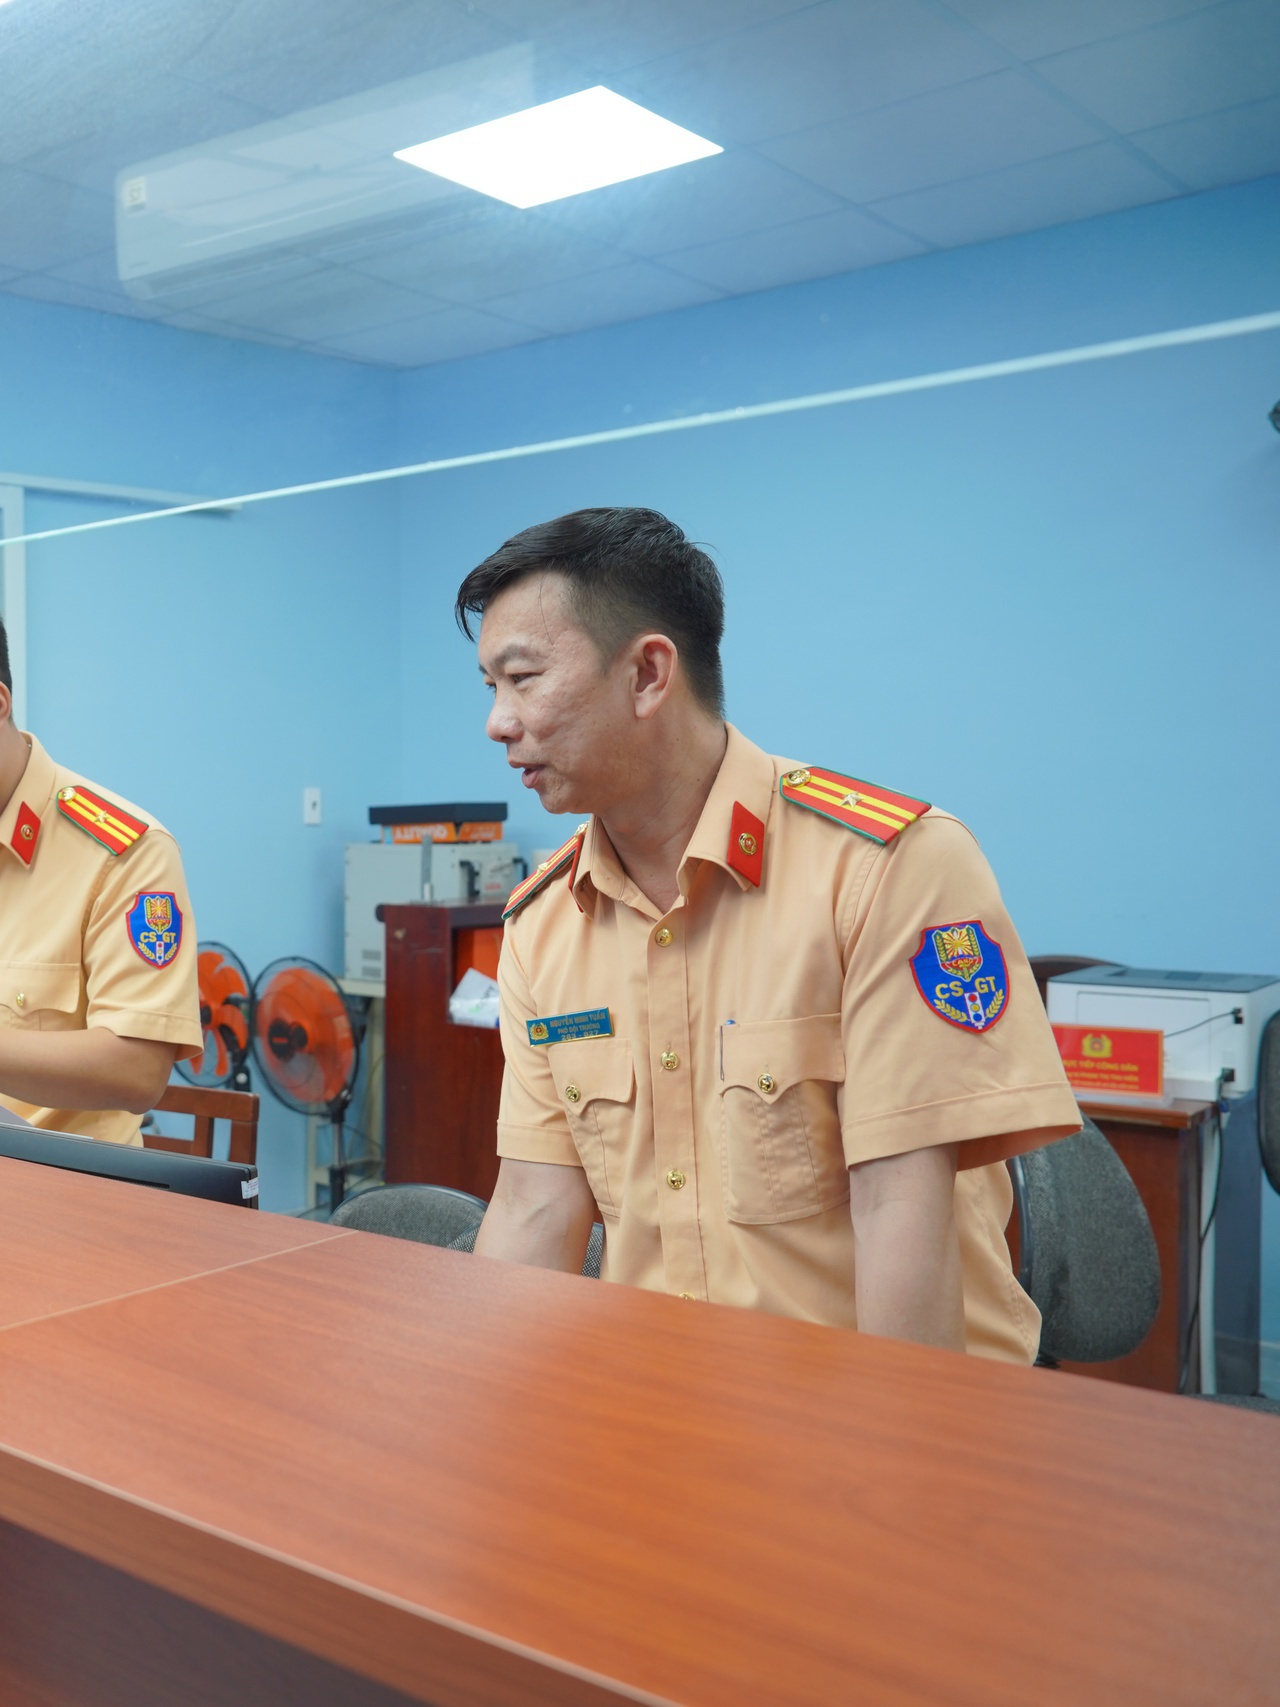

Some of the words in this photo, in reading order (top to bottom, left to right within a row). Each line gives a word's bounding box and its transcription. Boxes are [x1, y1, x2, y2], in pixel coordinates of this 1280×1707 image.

[140, 931, 157, 943] CS
[162, 931, 176, 943] GT
[935, 981, 964, 999] CS
[974, 976, 996, 994] GT
